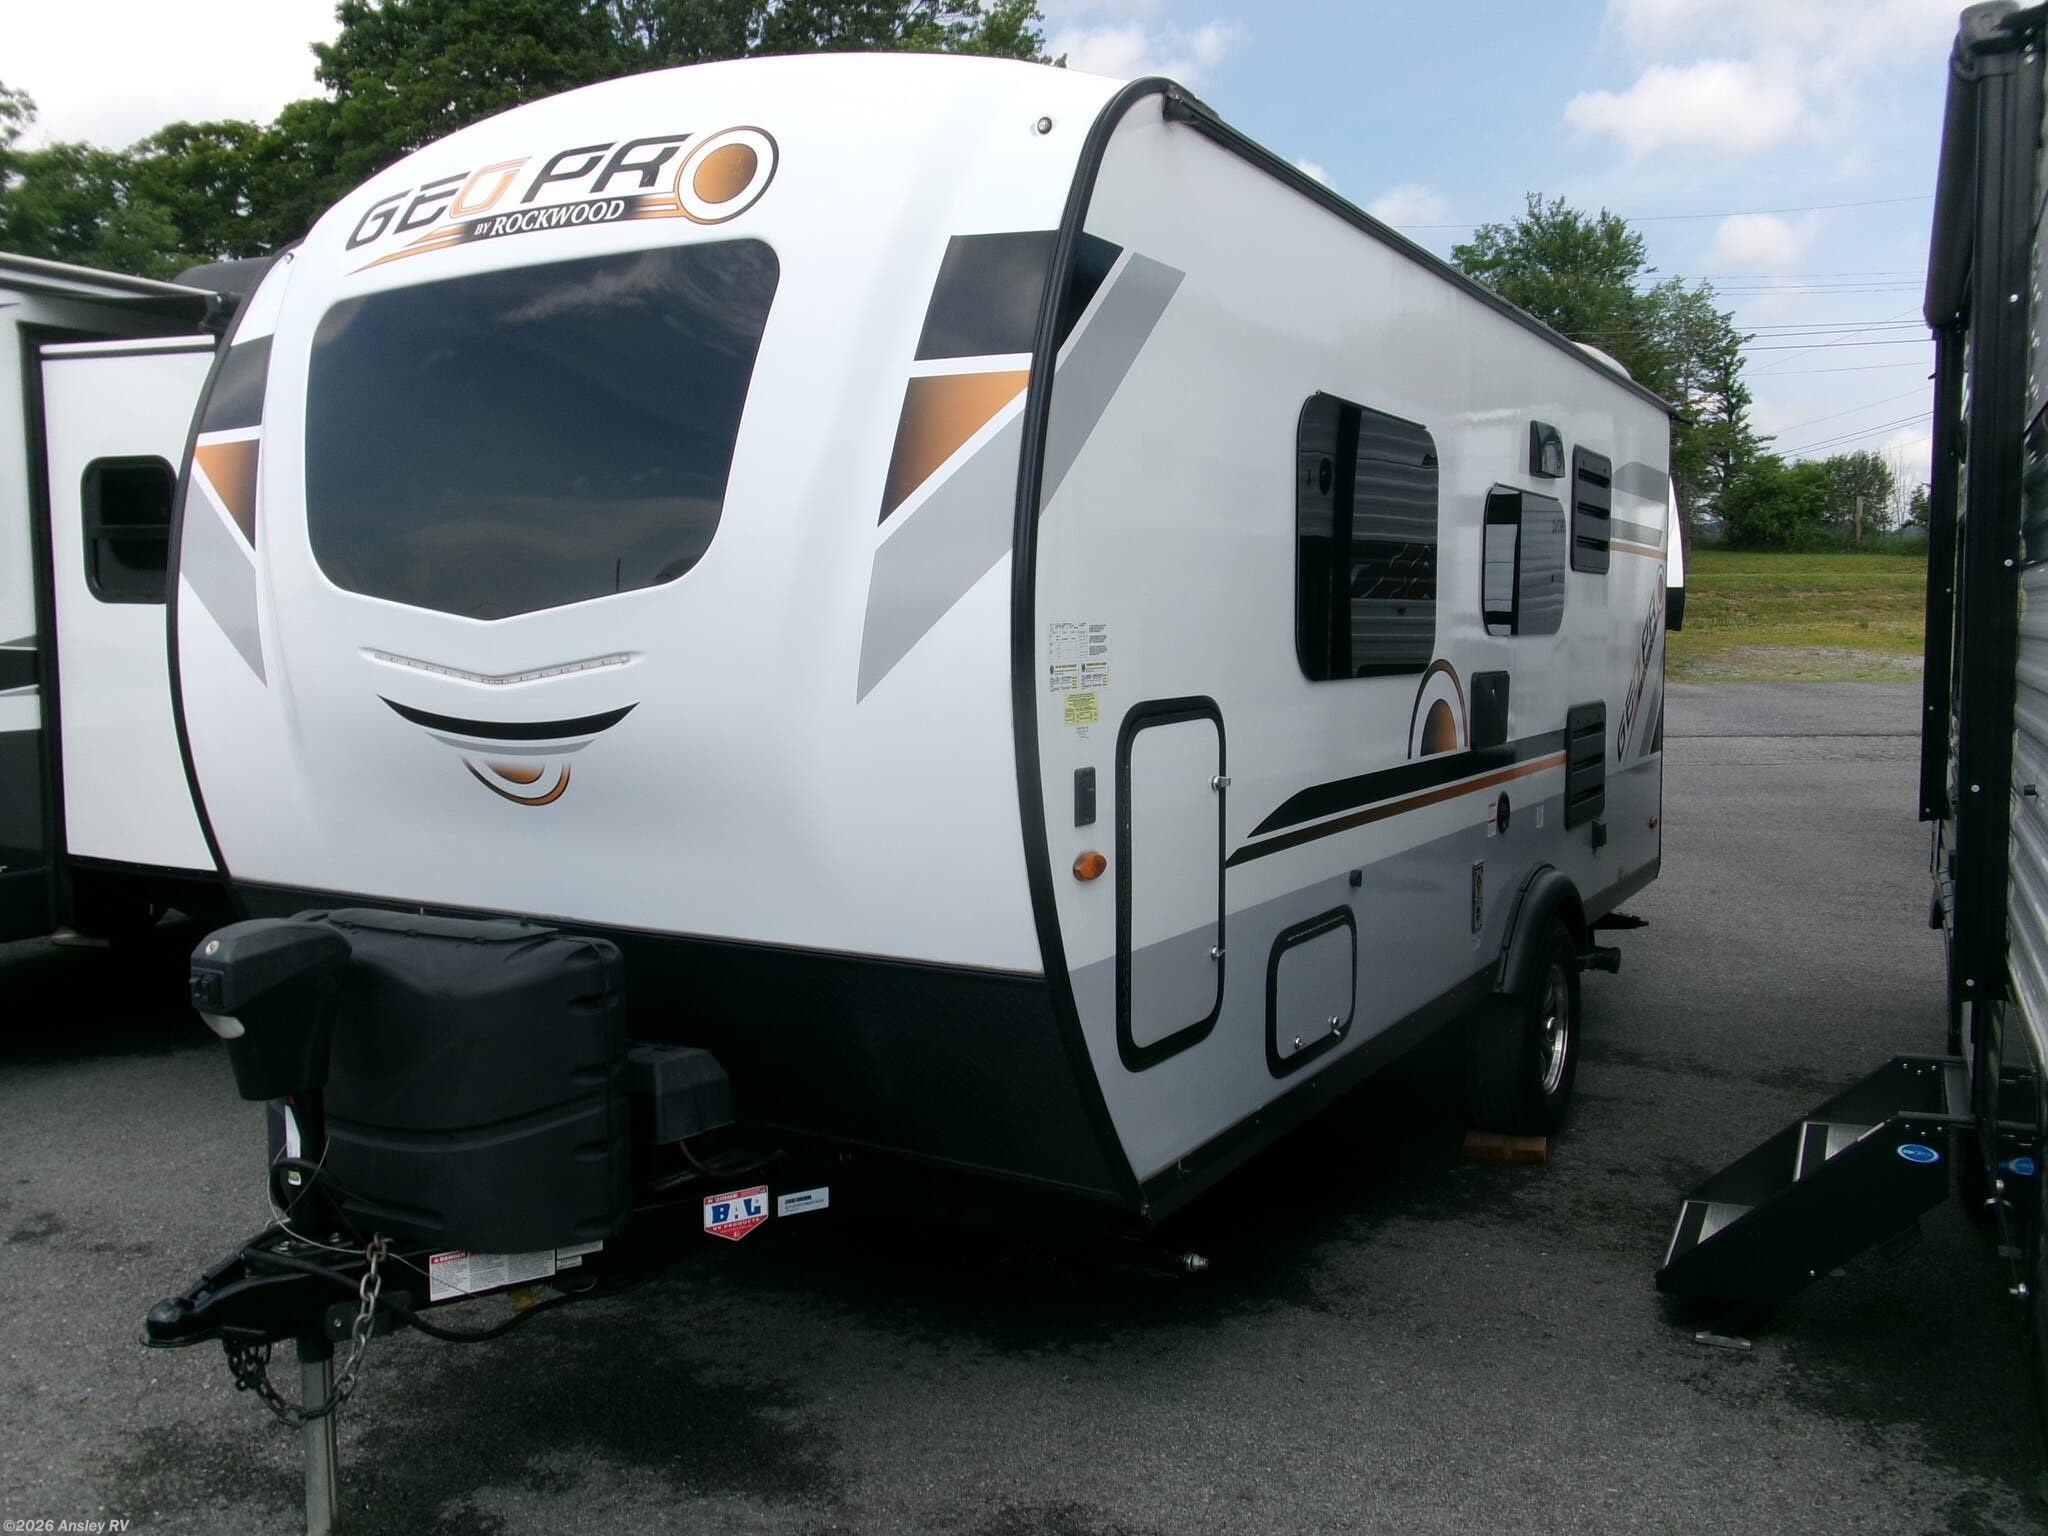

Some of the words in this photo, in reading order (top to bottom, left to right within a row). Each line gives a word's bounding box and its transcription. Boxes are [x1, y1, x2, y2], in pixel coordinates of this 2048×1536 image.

[345, 156, 532, 251] GEO
[522, 125, 779, 225] PRO
[474, 222, 491, 236] BY
[489, 199, 625, 236] ROCKWOOD
[711, 1197, 762, 1224] BAL
